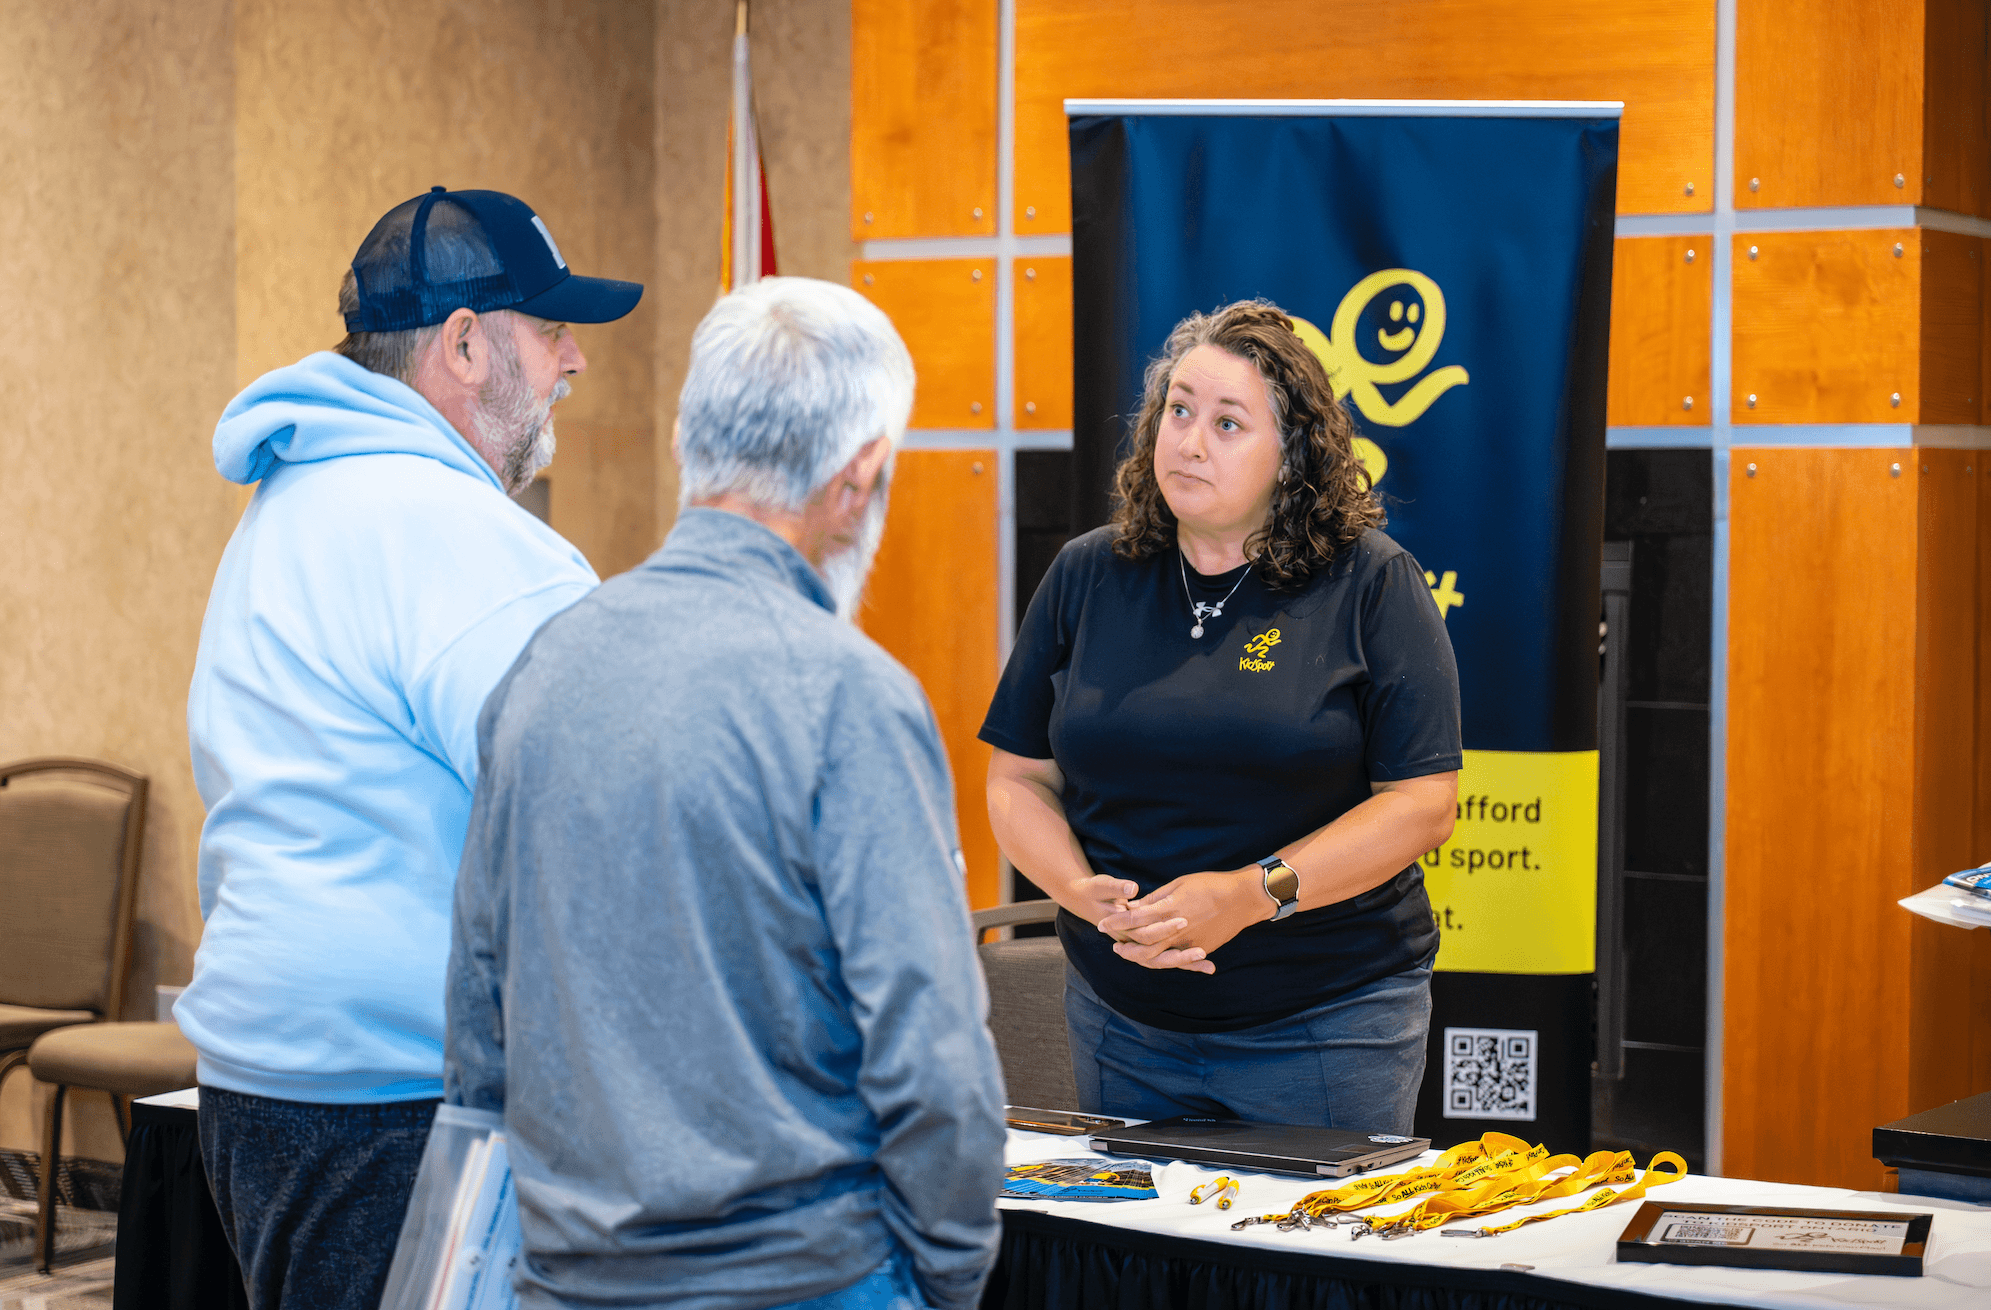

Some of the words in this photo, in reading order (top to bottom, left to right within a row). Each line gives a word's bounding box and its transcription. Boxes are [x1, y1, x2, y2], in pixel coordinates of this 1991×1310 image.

[1450, 847, 1541, 875] sport.
[1391, 1194, 1402, 1202] So
[1401, 1187, 1415, 1199] ALL
[1413, 1184, 1427, 1193] Kids
[1830, 1221, 1901, 1229] DONATE
